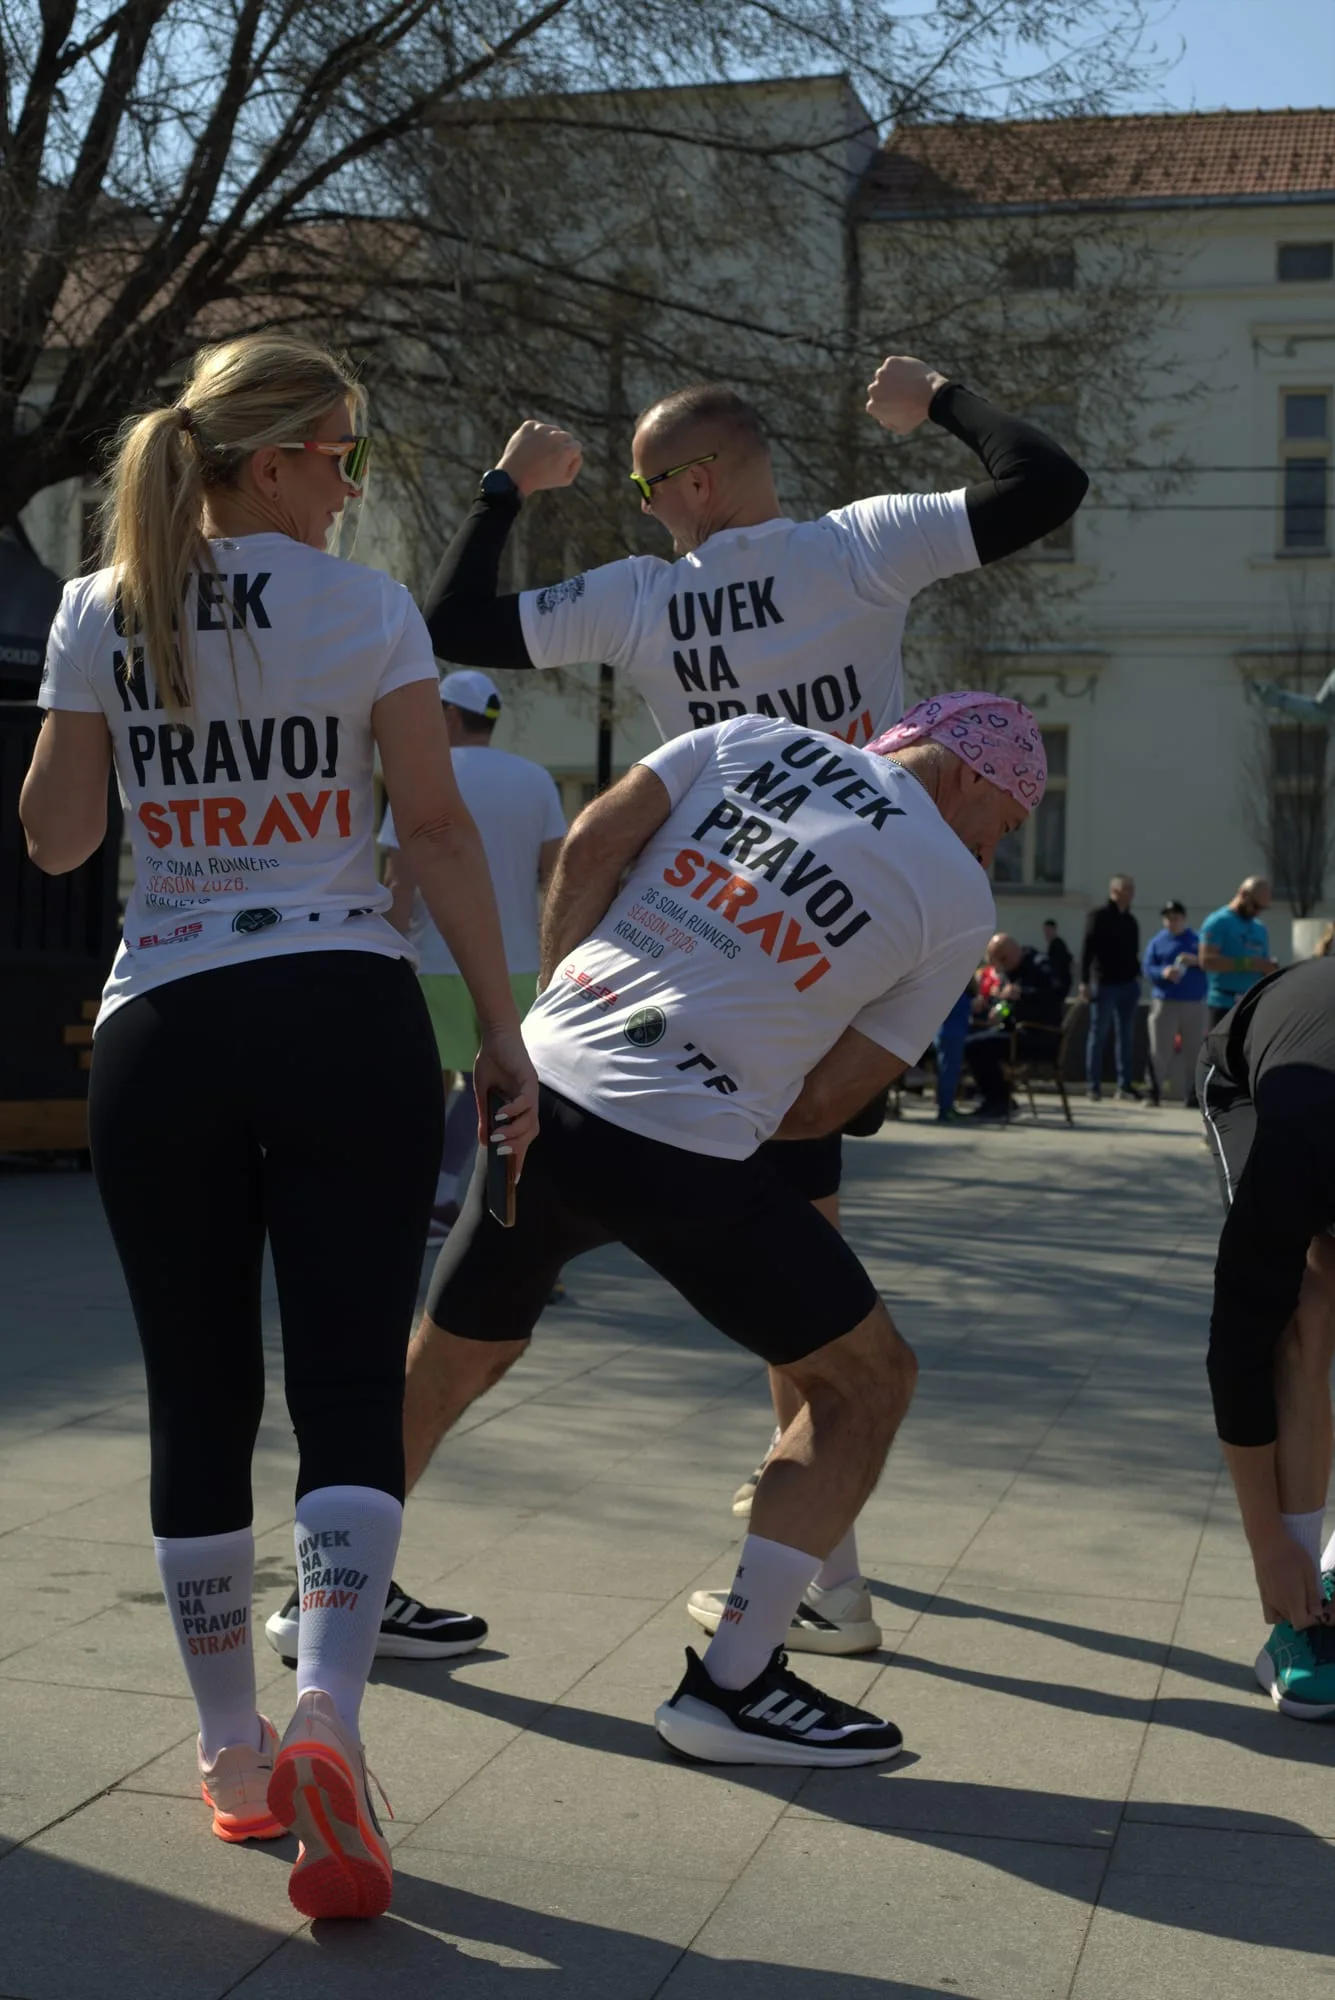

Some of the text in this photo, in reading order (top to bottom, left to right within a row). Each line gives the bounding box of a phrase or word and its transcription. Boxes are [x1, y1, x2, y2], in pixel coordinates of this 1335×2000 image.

[113, 572, 273, 638] UEK
[668, 575, 785, 641] UVEK
[673, 644, 740, 693] NA
[129, 716, 339, 787] PRAVOJ
[734, 760, 813, 824] NA
[781, 736, 907, 831] UVEK
[138, 789, 351, 849] STRAVI
[691, 799, 872, 948] PRAVOJ
[612, 919, 665, 959] KRALJEVO
[627, 902, 670, 936] SEASON
[641, 887, 741, 960] 36 SOMA RUNNERS
[663, 848, 832, 993] STRAVI
[299, 1530, 352, 1558] UVEK
[302, 1552, 322, 1575] NA
[177, 1575, 233, 1598] UVEK
[302, 1589, 358, 1613] STRAVI
[303, 1567, 369, 1594] PRAVOJ
[179, 1599, 206, 1616] NA
[183, 1607, 247, 1635] PRAVOJ
[188, 1626, 247, 1656] STRAVI
